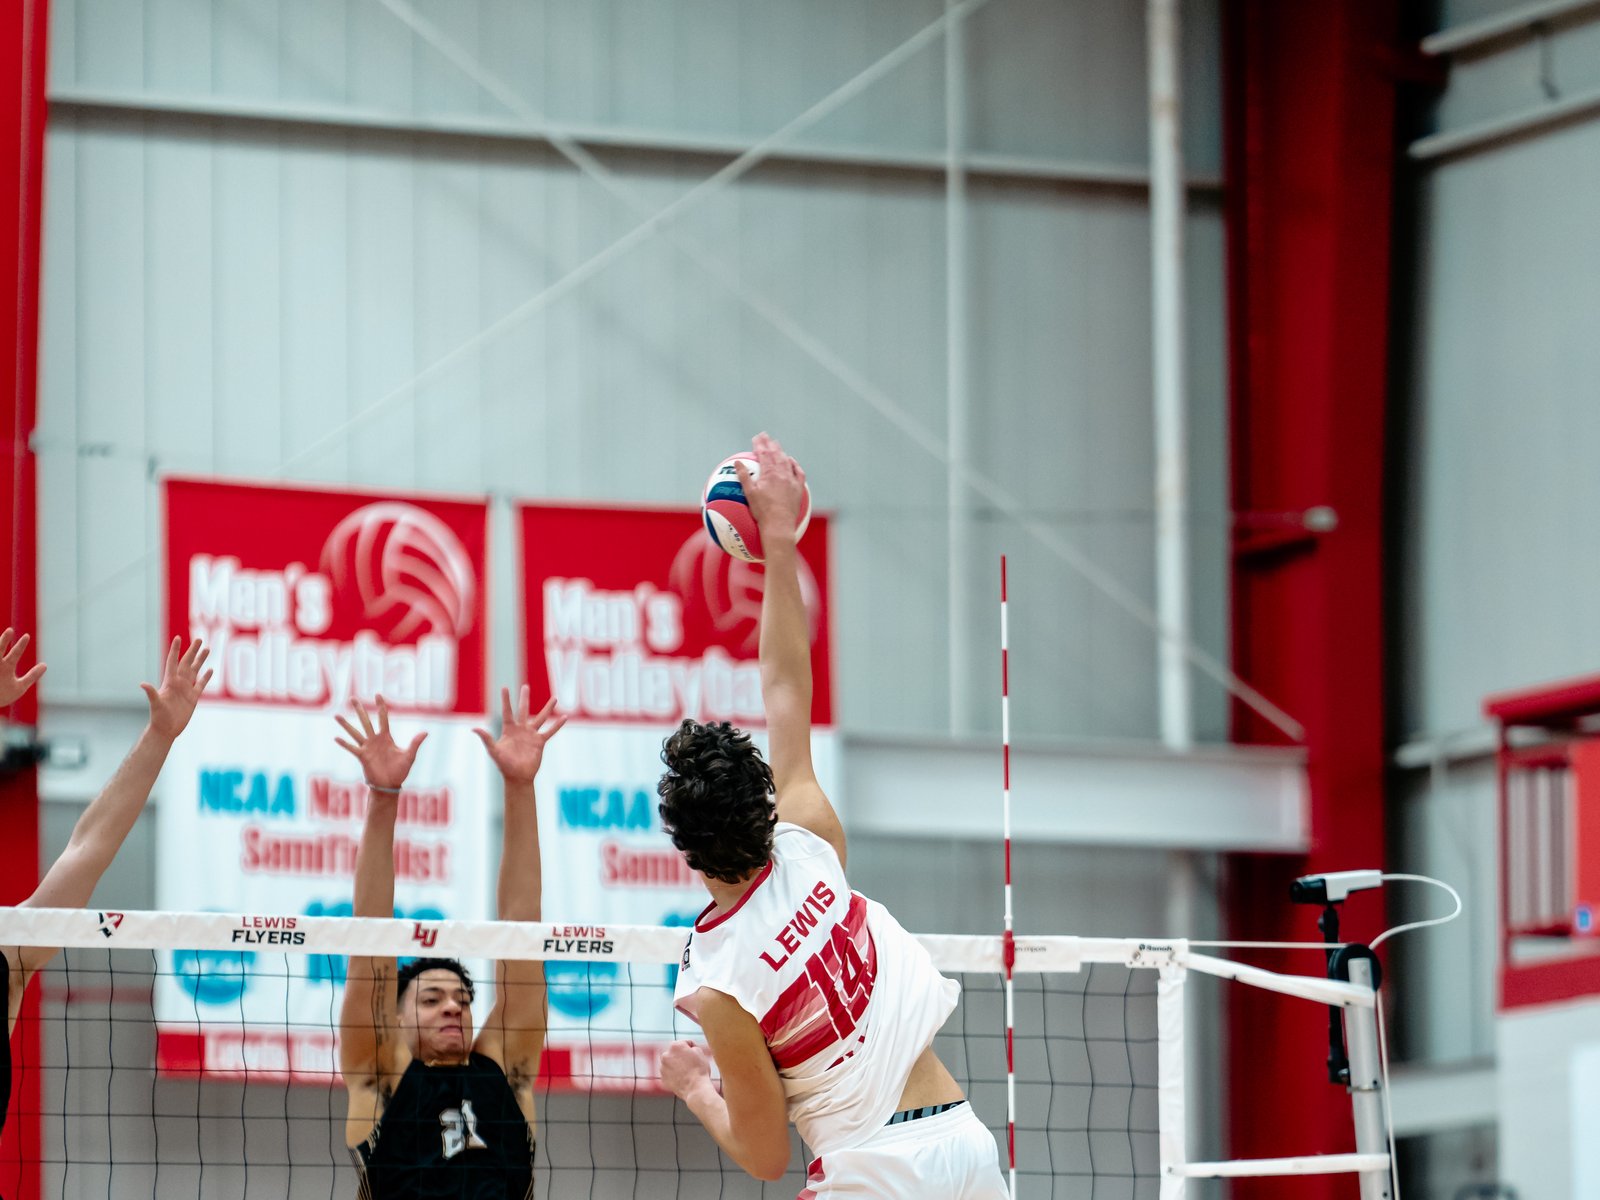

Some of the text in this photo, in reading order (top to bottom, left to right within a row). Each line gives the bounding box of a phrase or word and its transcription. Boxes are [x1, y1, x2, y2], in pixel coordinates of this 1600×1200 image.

[189, 555, 332, 634] Men's
[543, 577, 684, 653] Men's
[192, 625, 457, 712] Volleyball
[547, 645, 766, 718] Volleyba
[198, 768, 296, 817] NCAA
[231, 930, 306, 945] FLYERS
[242, 916, 297, 929] LEWIS
[543, 939, 614, 954] FLYERS
[552, 926, 606, 938] LEWIS
[759, 879, 836, 972] LEWIS
[804, 922, 877, 1041] 14
[439, 1098, 488, 1160] 21
